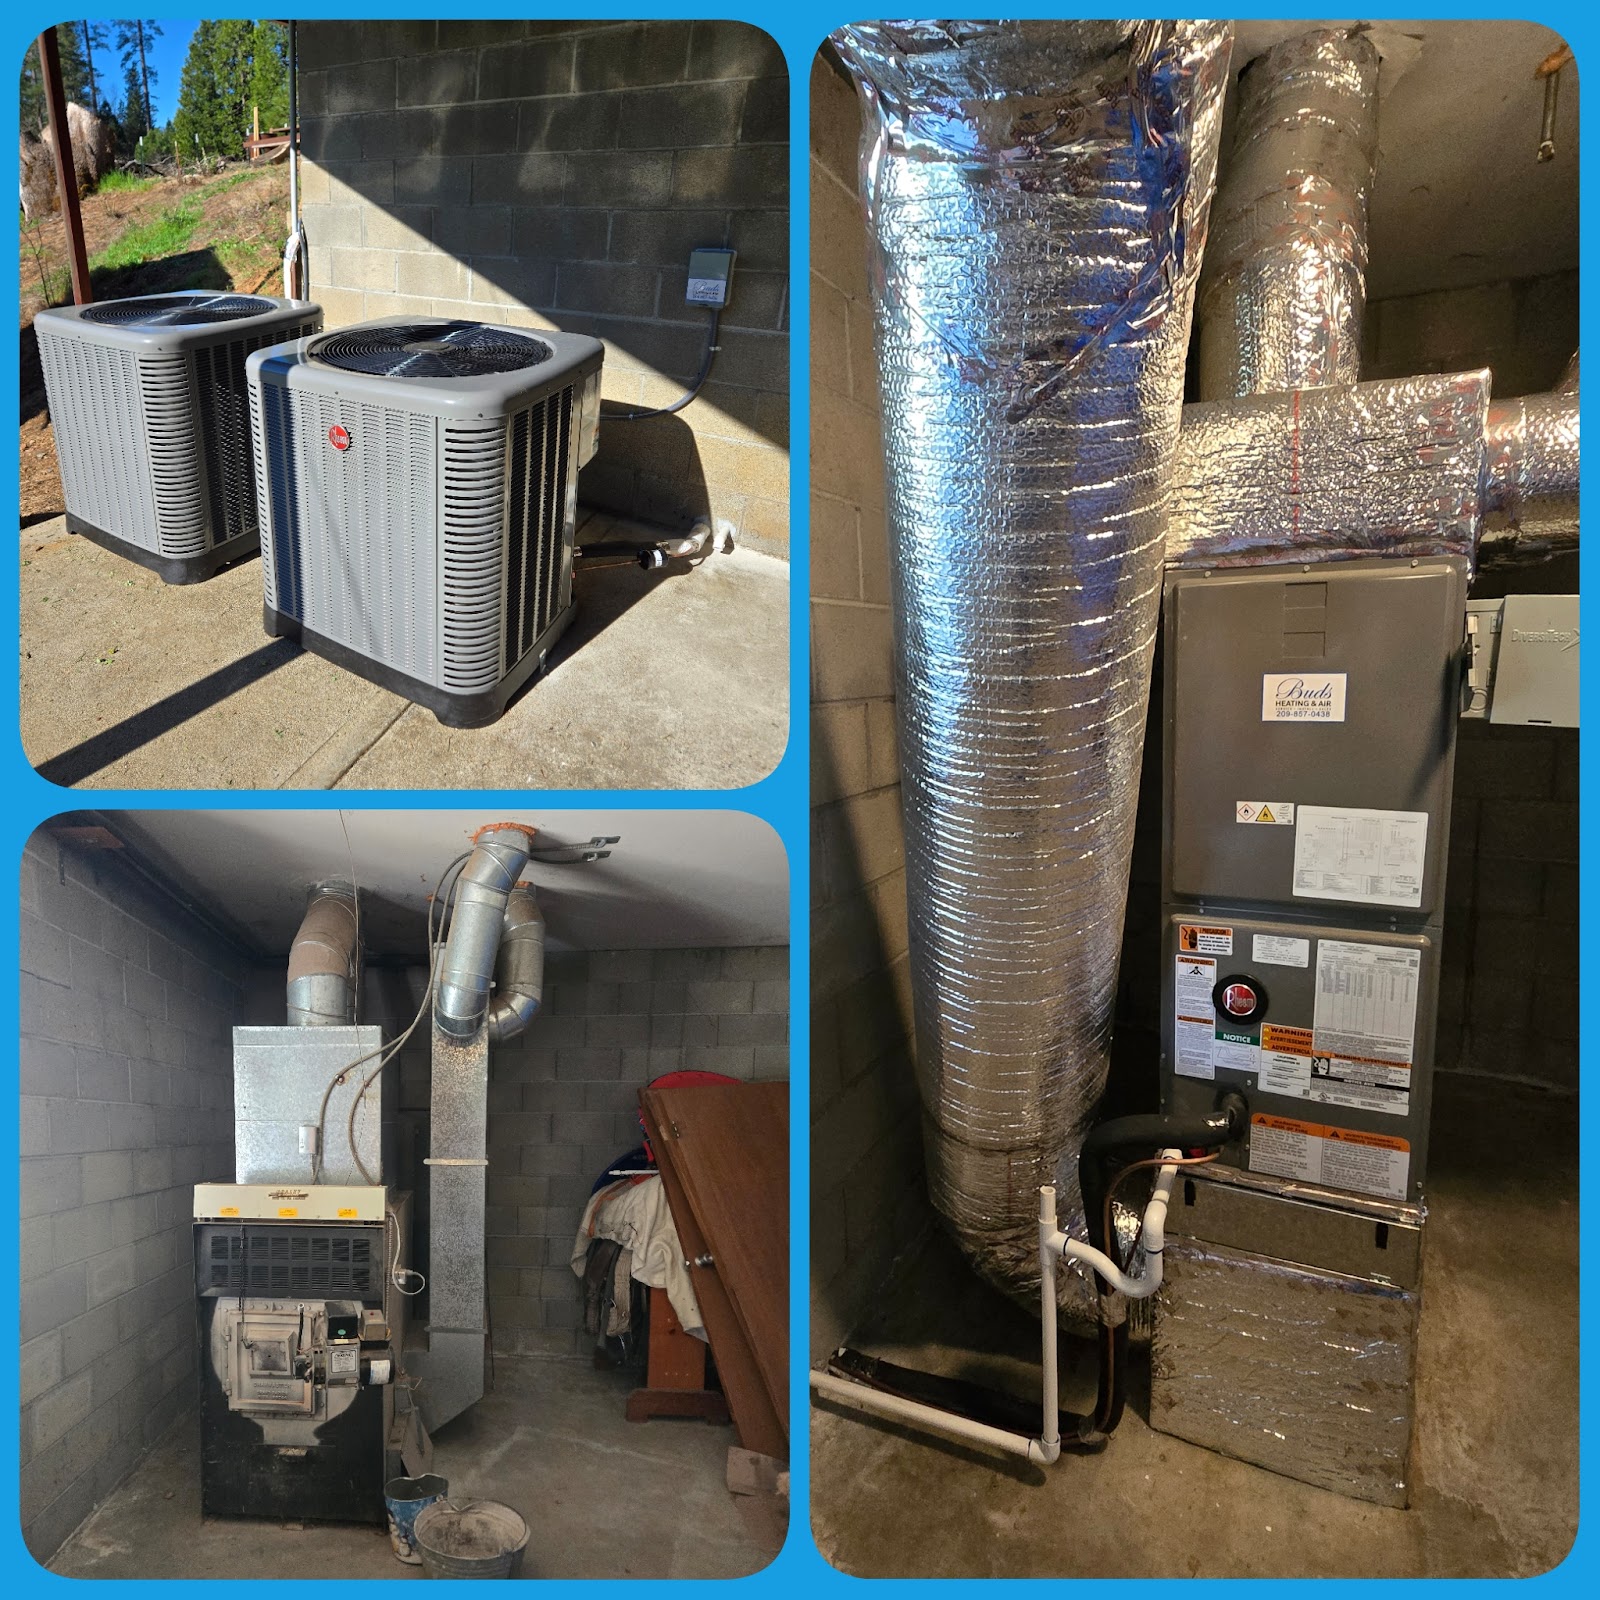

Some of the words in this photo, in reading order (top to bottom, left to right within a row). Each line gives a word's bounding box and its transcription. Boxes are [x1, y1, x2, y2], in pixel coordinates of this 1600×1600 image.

[1275, 678, 1333, 700] Buds
[1276, 710, 1331, 718] 209-857-0438
[1226, 987, 1254, 1010] Rheem
[1223, 1033, 1251, 1043] NOTICE
